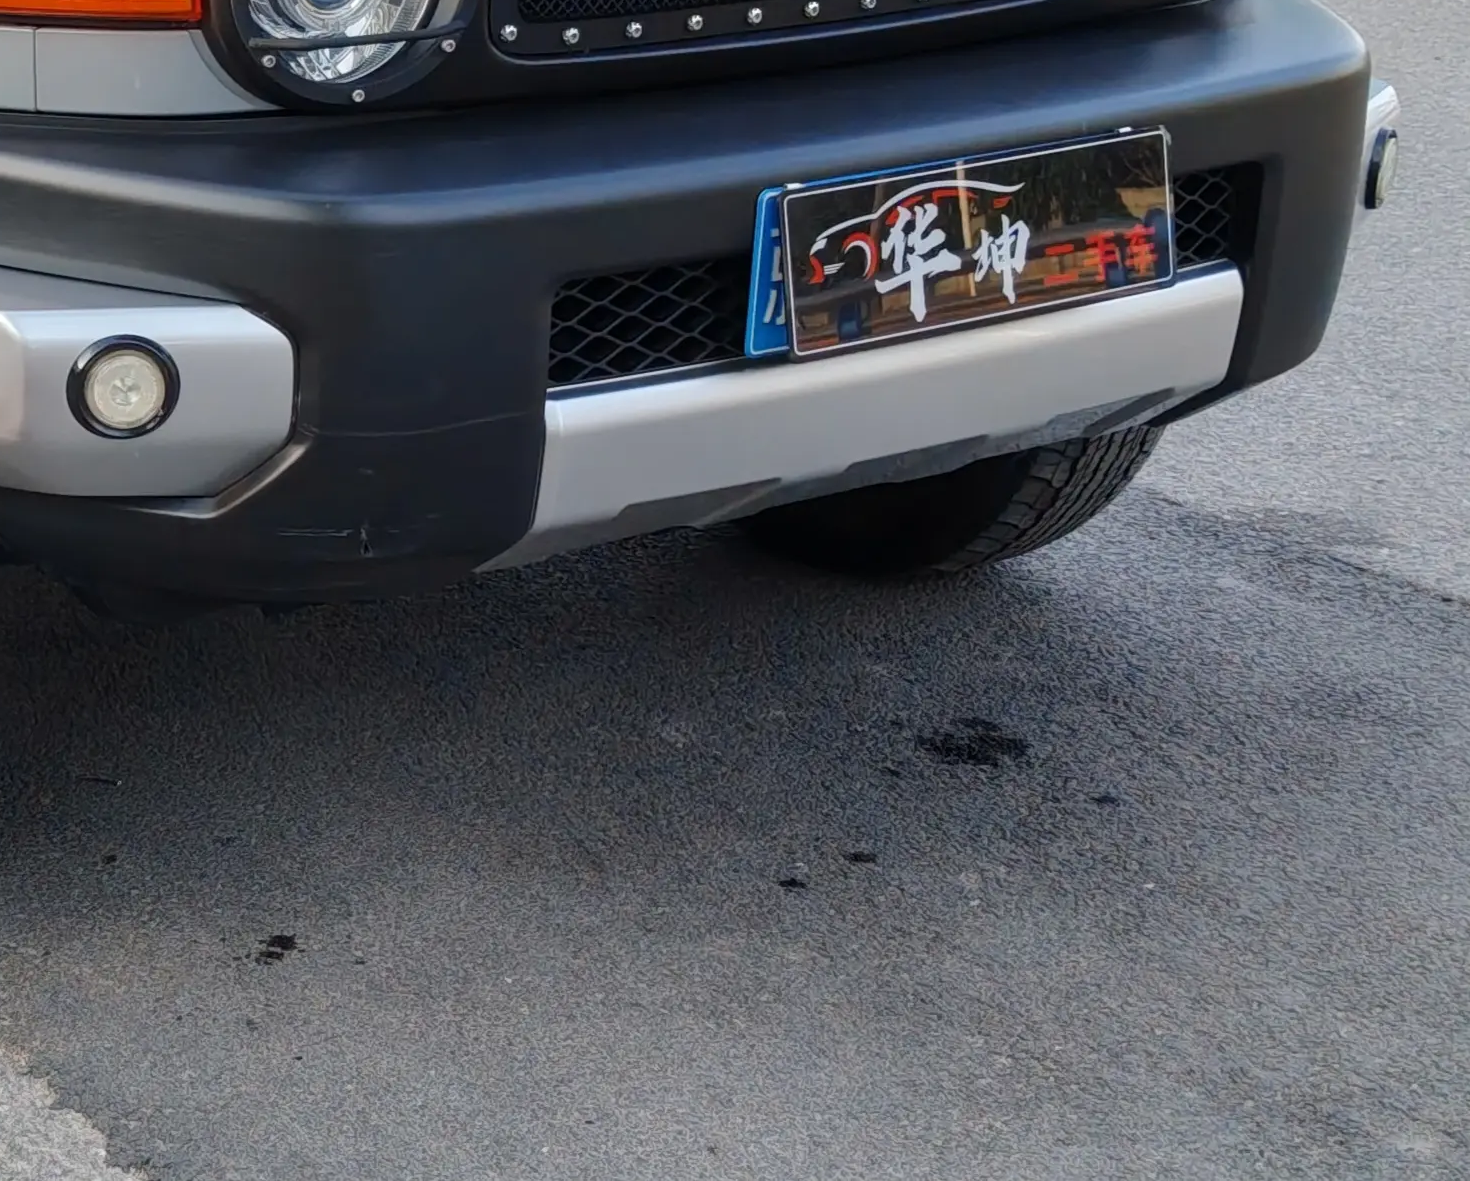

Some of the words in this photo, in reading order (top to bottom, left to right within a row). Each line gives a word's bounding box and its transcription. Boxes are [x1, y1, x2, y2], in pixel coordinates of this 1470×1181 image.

[874, 203, 1032, 323] 华坤
[1043, 223, 1159, 287] 二手车
